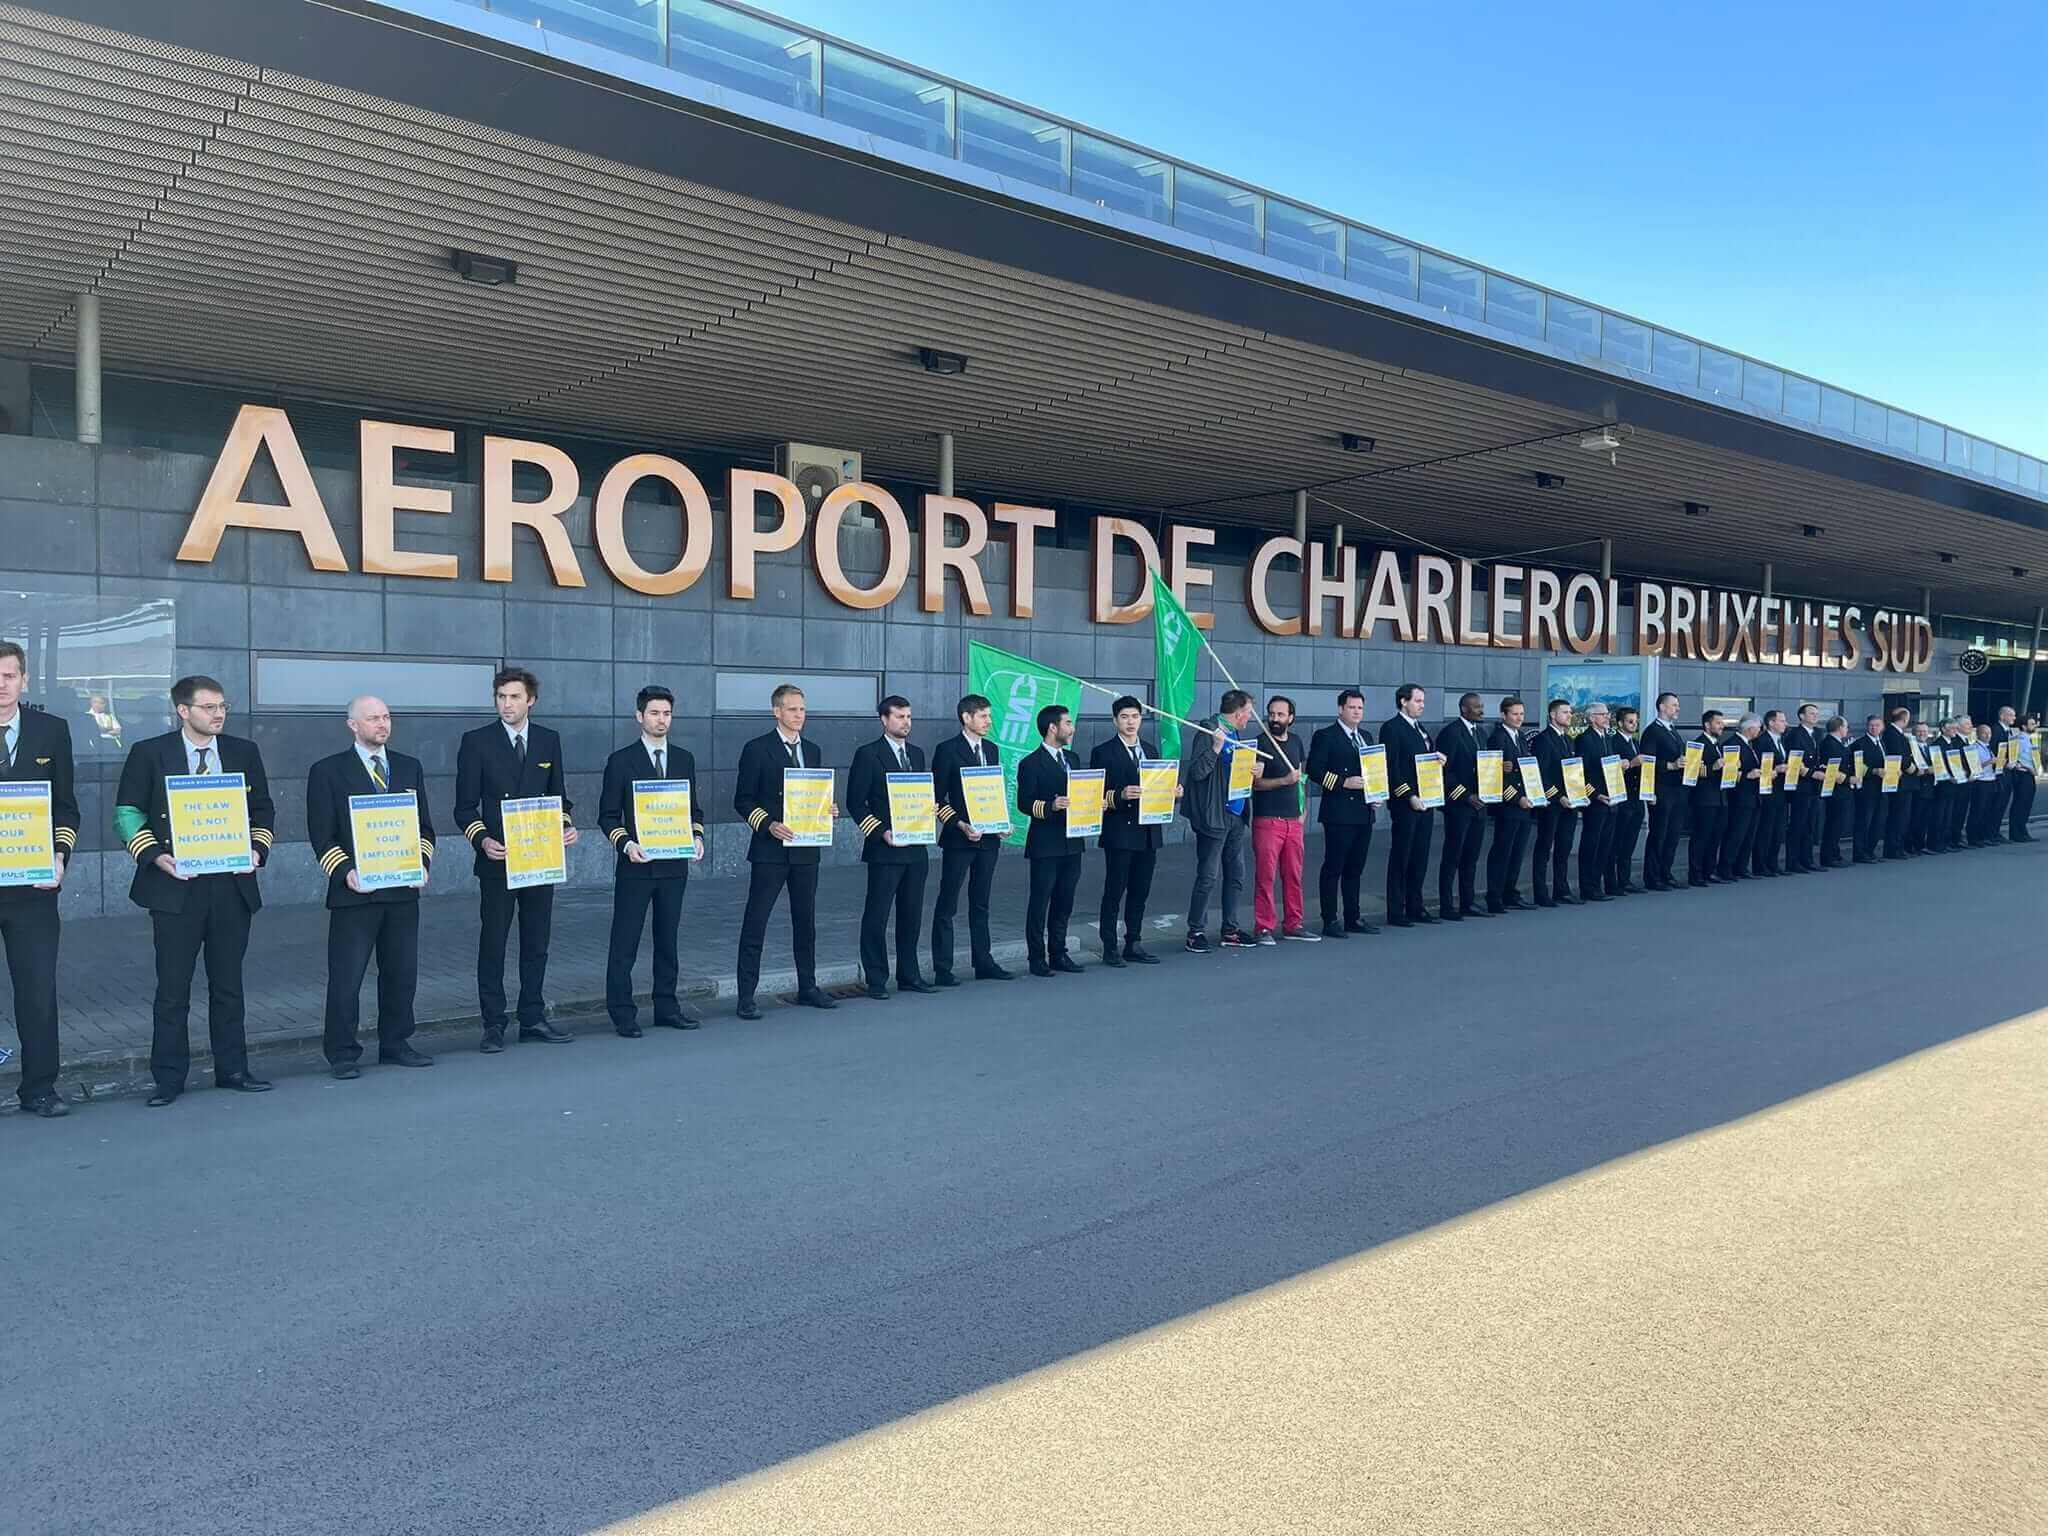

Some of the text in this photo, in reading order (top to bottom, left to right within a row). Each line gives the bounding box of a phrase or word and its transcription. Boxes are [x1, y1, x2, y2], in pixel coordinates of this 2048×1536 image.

[175, 403, 1933, 673] AEROPORT DE CHARLEROI BRUXELLES SUD
[184, 801, 230, 810] THE LAW
[206, 817, 228, 825] NOT
[366, 820, 405, 829] RESPECT
[178, 832, 243, 843] NEGOTIABLE
[376, 834, 400, 842] YOUR
[363, 849, 416, 859] EMPLOYEES
